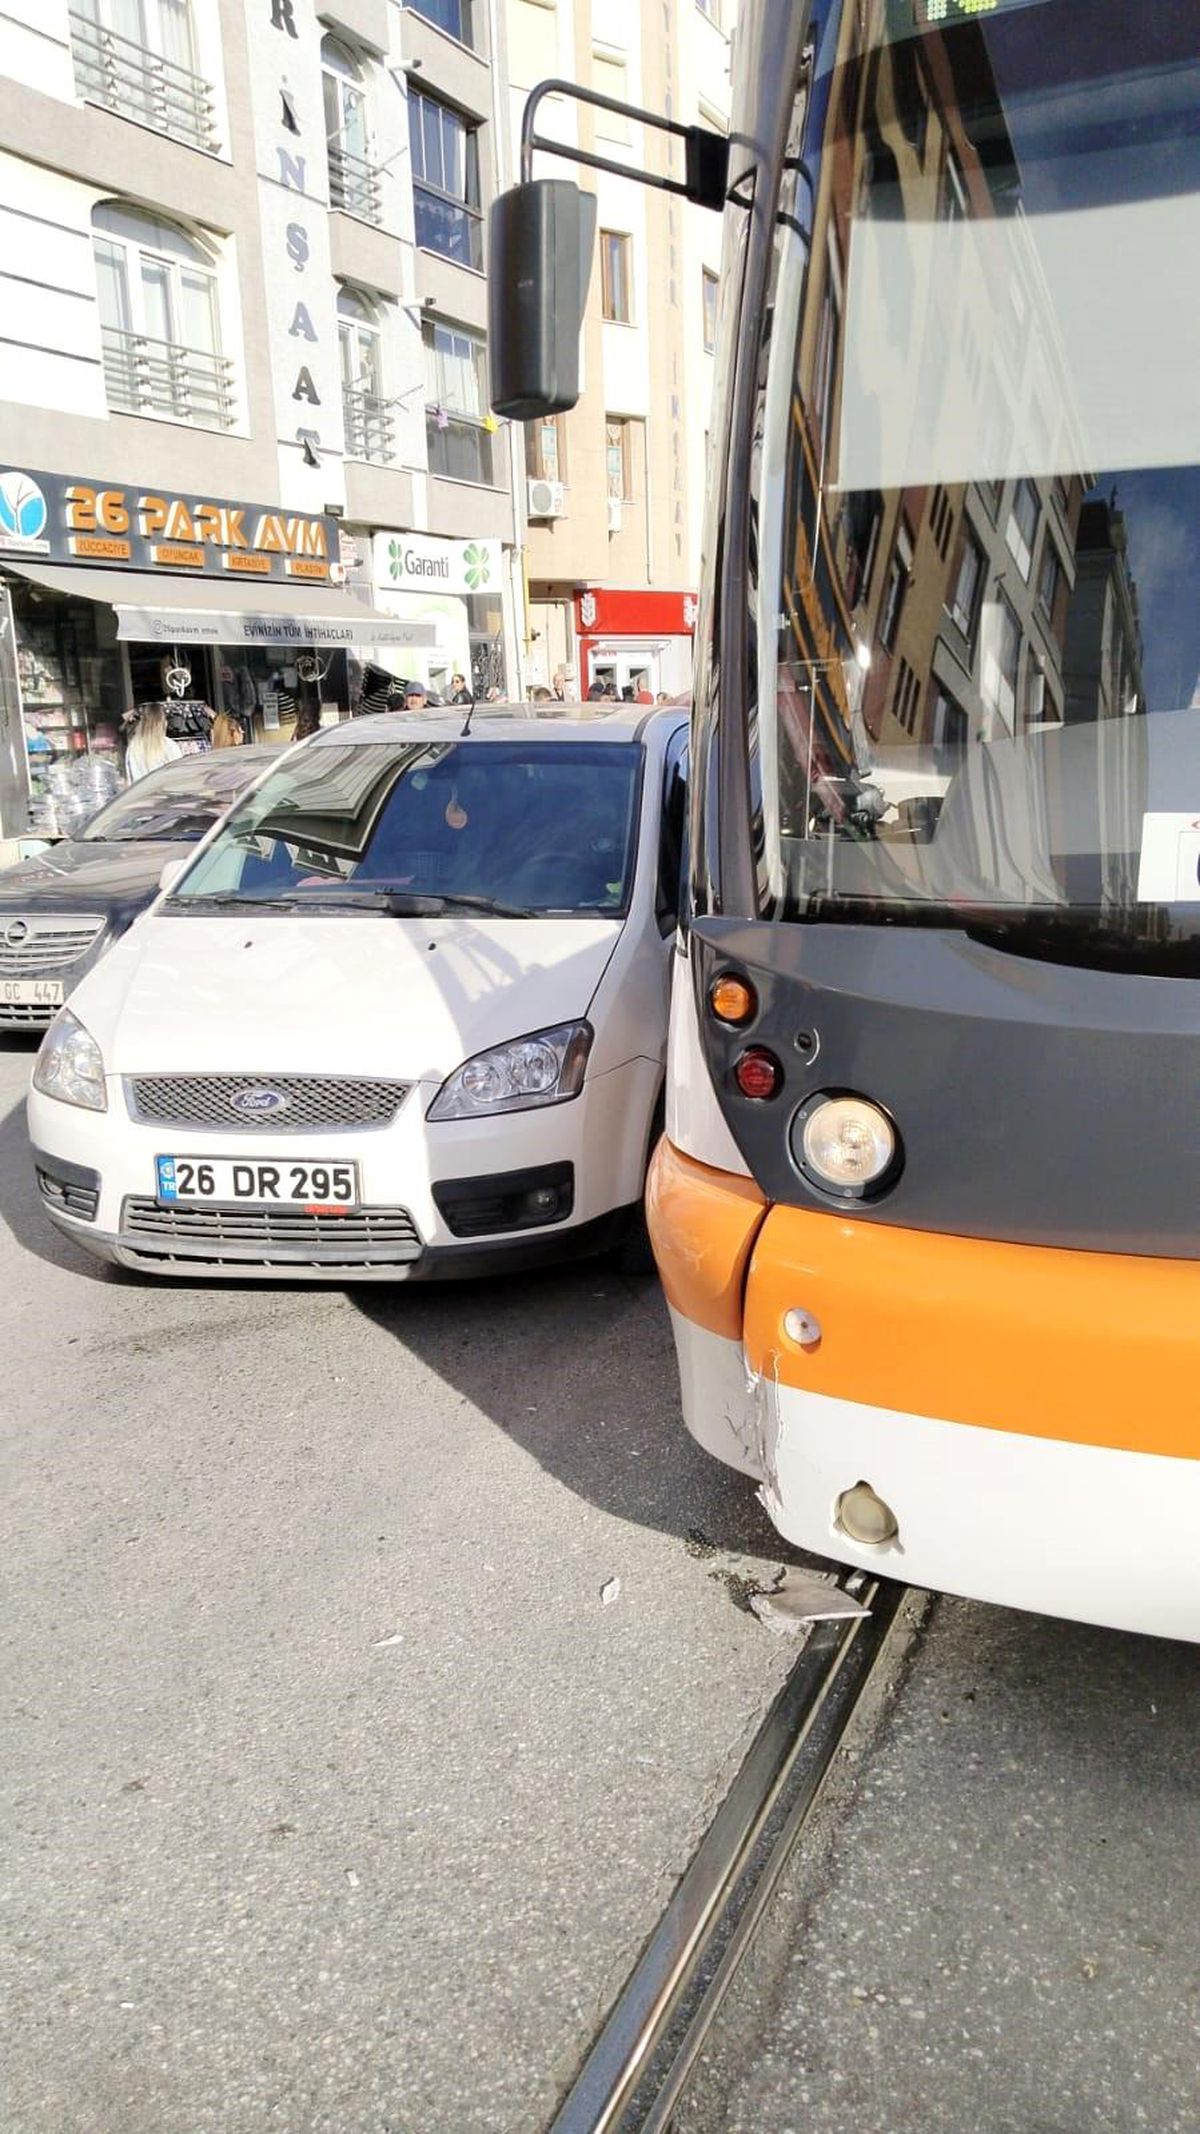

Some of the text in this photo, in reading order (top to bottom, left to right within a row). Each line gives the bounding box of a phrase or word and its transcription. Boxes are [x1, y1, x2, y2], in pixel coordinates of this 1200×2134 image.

[65, 486, 129, 533] 26
[137, 496, 248, 548] PARK
[253, 514, 328, 558] AVM
[404, 549, 449, 578] Garanti
[34, 982, 60, 1001] 447
[241, 1092, 272, 1107] Ford
[162, 1181, 177, 1192] TR
[176, 1163, 352, 1201] 26 DR 295
